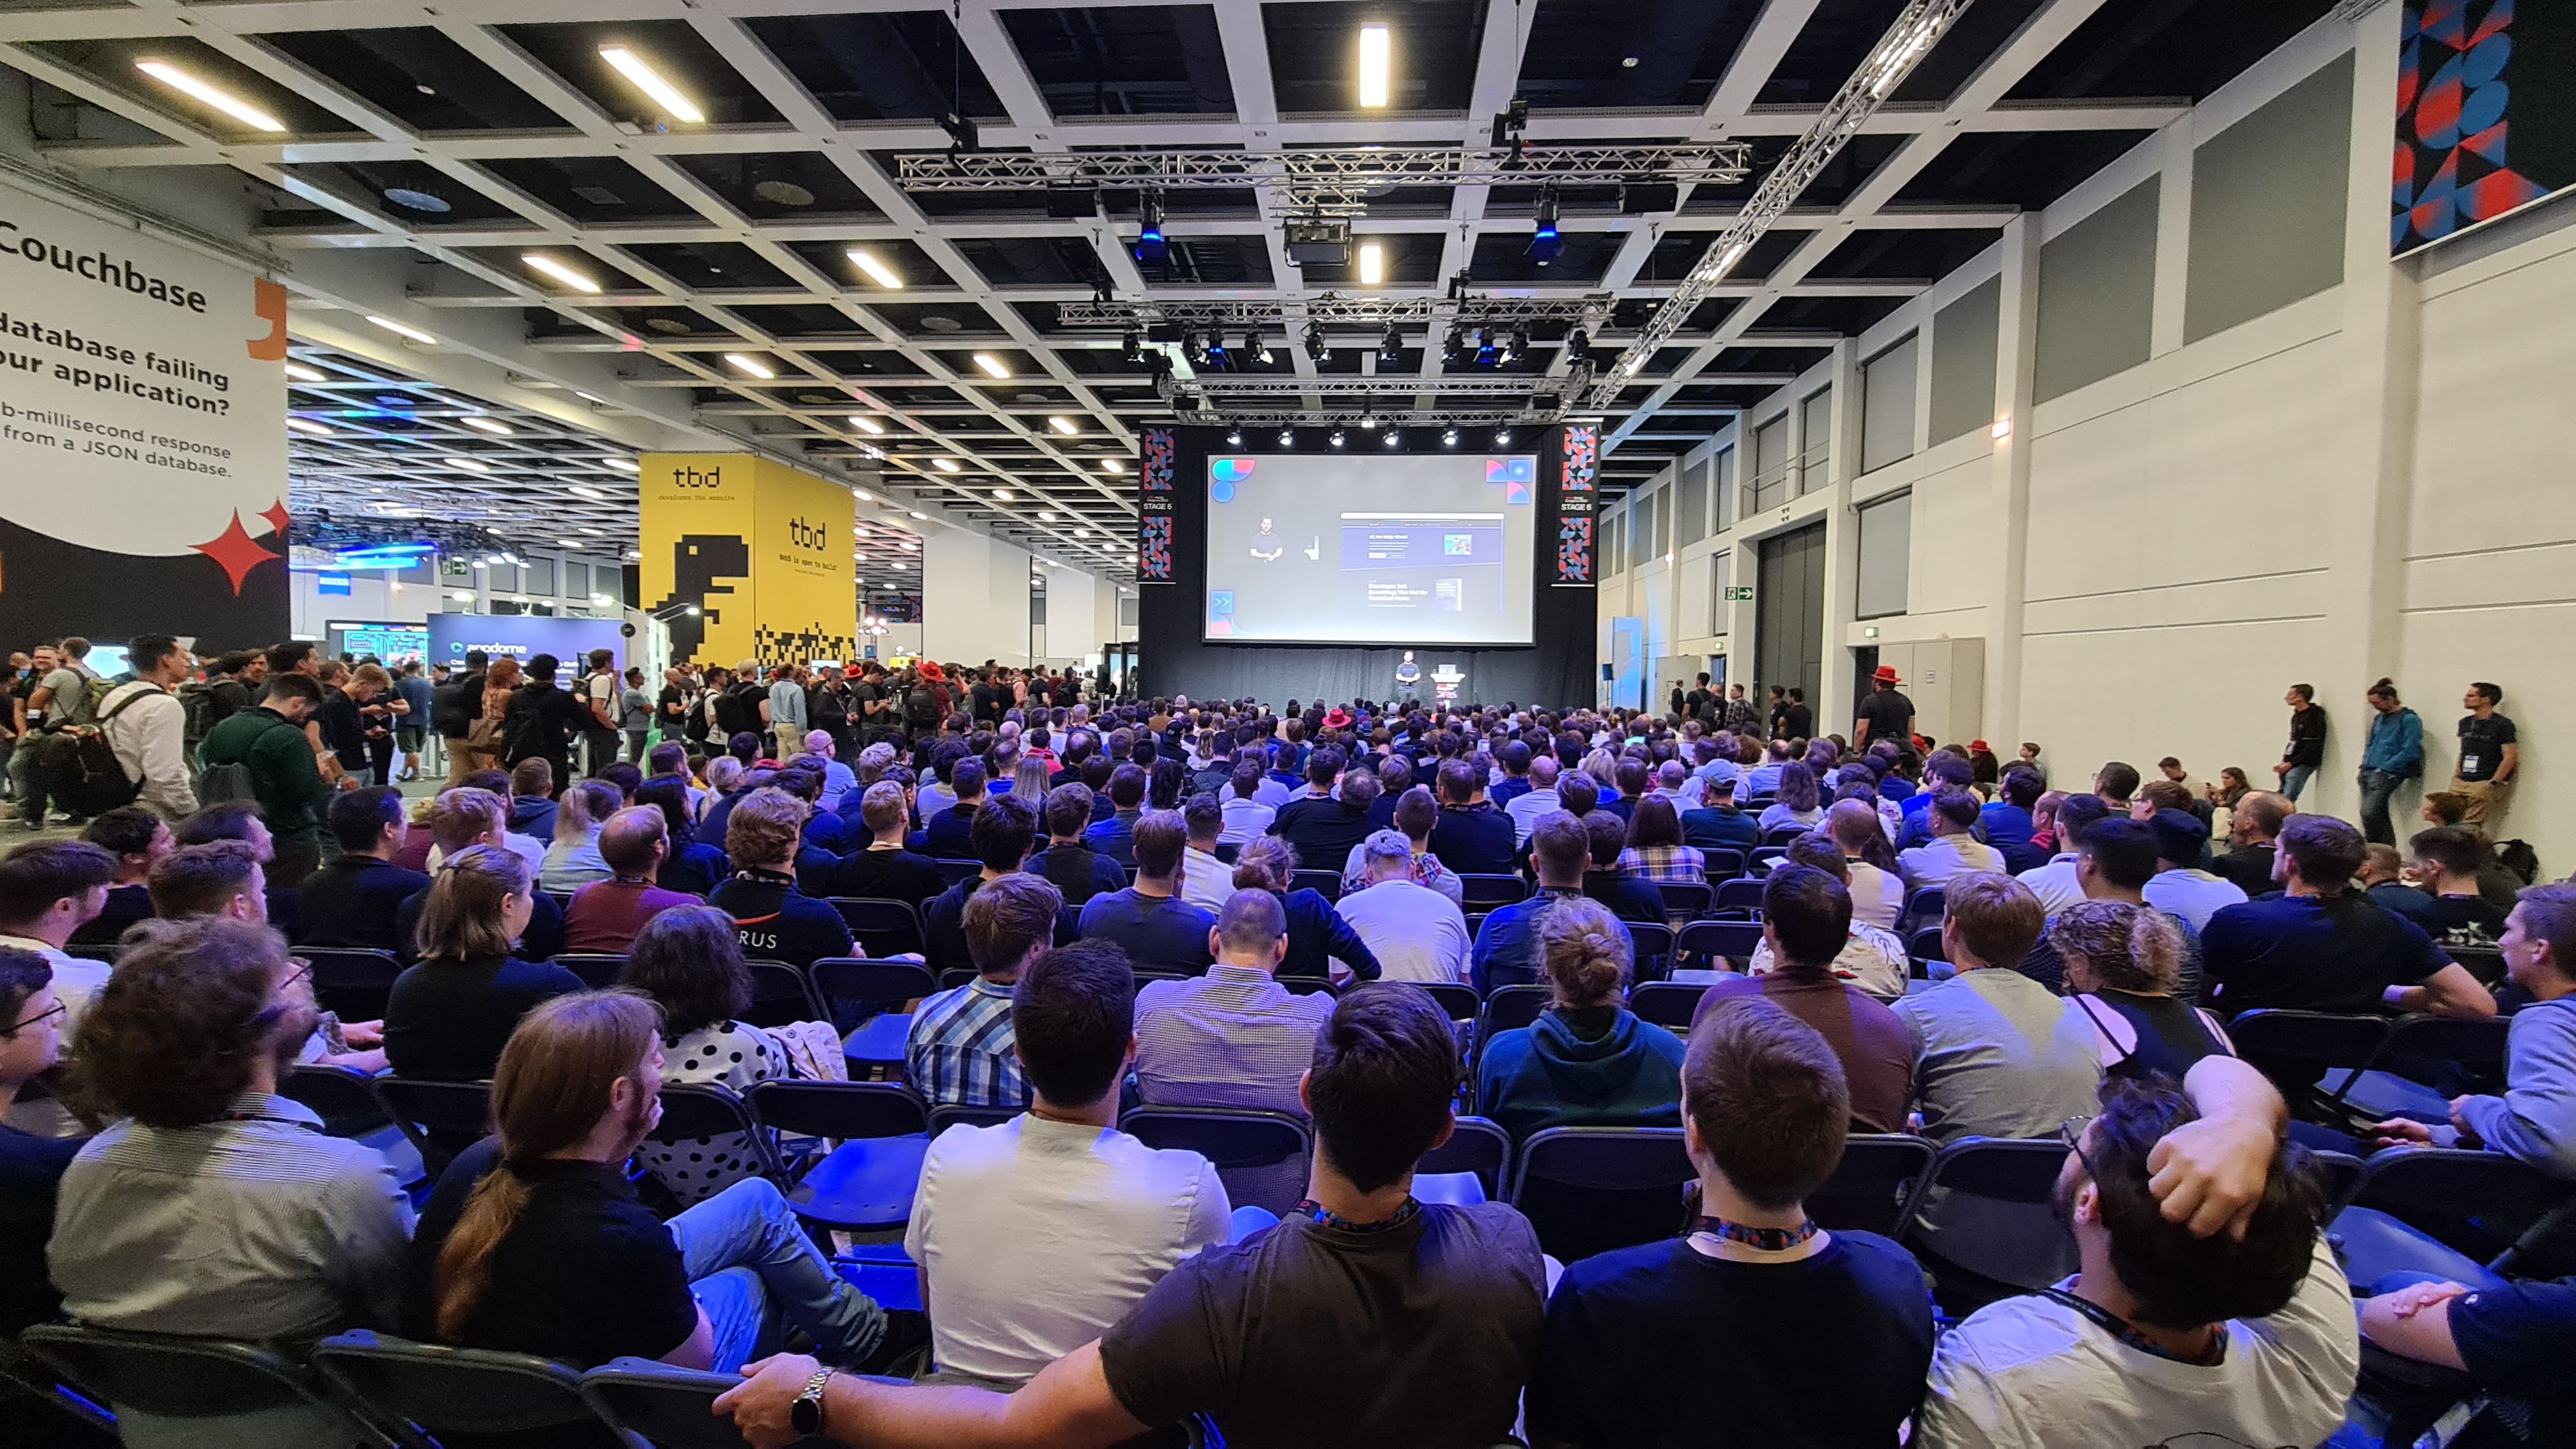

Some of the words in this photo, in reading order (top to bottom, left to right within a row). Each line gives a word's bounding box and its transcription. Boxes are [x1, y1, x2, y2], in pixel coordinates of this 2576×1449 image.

[0, 221, 206, 313] Couchbase
[54, 363, 229, 416] application?
[145, 352, 229, 392] failing
[4, 424, 56, 447] from
[63, 439, 75, 450] a
[83, 440, 139, 461] JSON
[145, 451, 232, 478] database.
[151, 434, 231, 459] response
[673, 466, 719, 487] tbd
[790, 516, 825, 551] tbd
